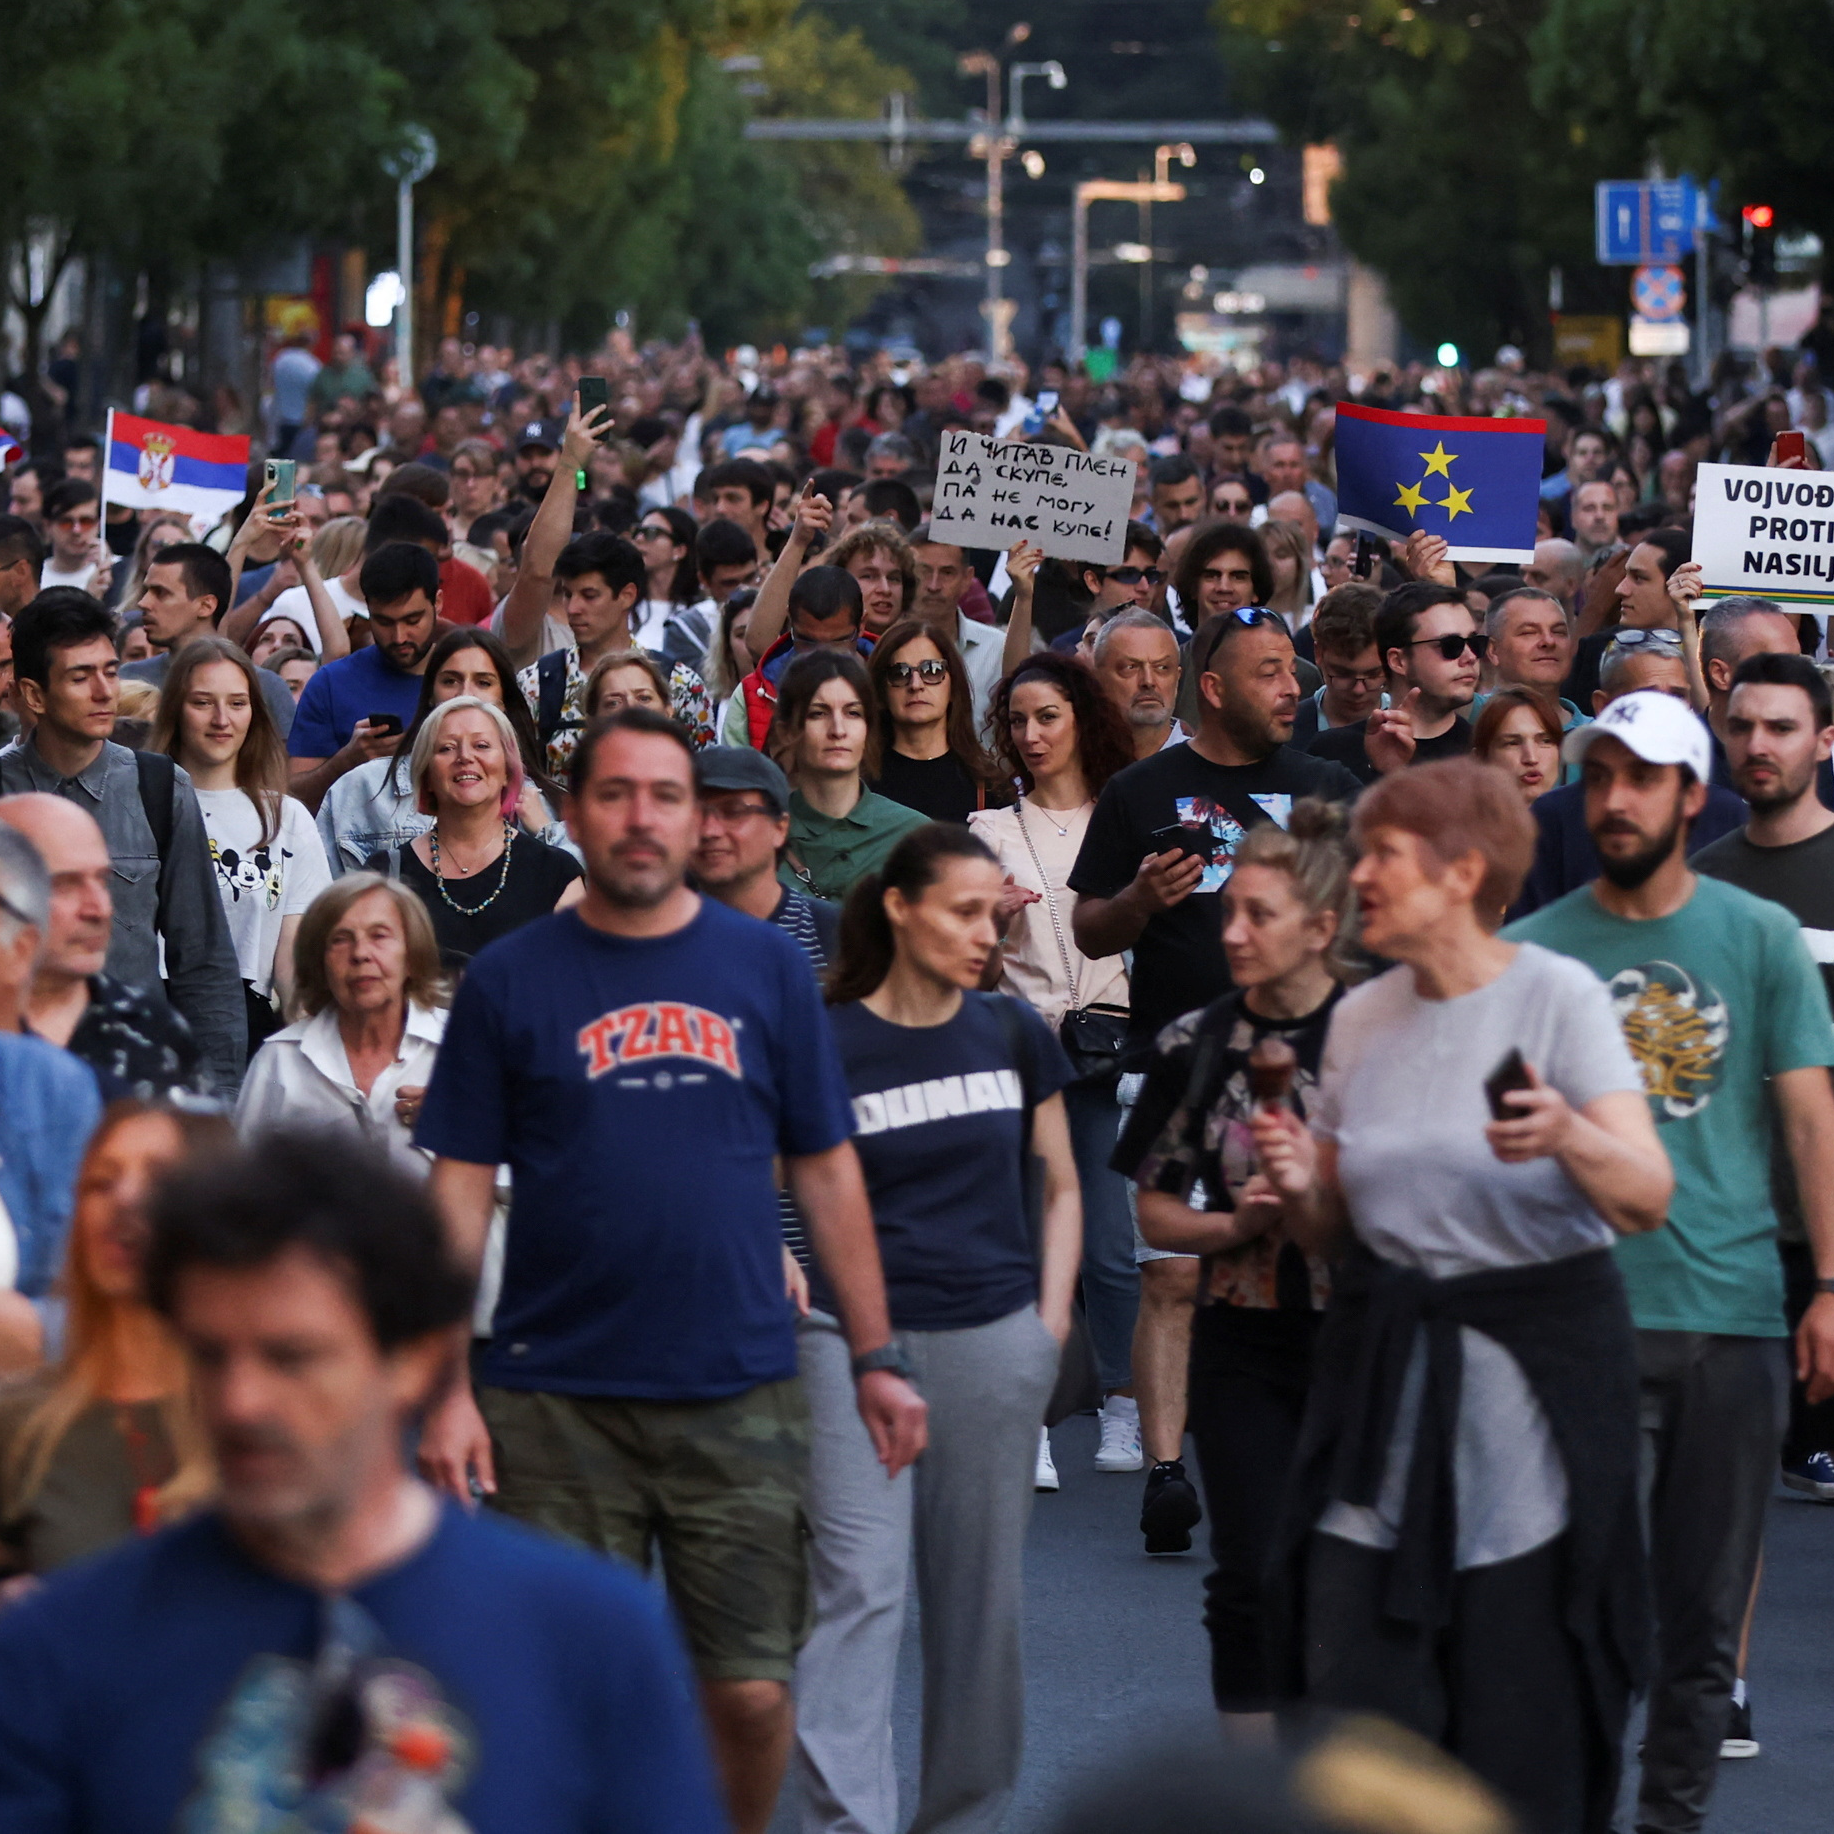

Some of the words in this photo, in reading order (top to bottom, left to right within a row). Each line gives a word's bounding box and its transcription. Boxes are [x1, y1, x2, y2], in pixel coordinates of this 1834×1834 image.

[949, 435, 967, 455] И
[980, 439, 1055, 466] ЧИТАВ
[943, 460, 981, 477] ДА
[943, 482, 976, 498] ПА
[991, 488, 1021, 504] НЕ
[1036, 494, 1096, 515] МОГУ
[936, 505, 976, 522] ДА
[990, 512, 1040, 531] НАС
[576, 1001, 744, 1081] TZAR
